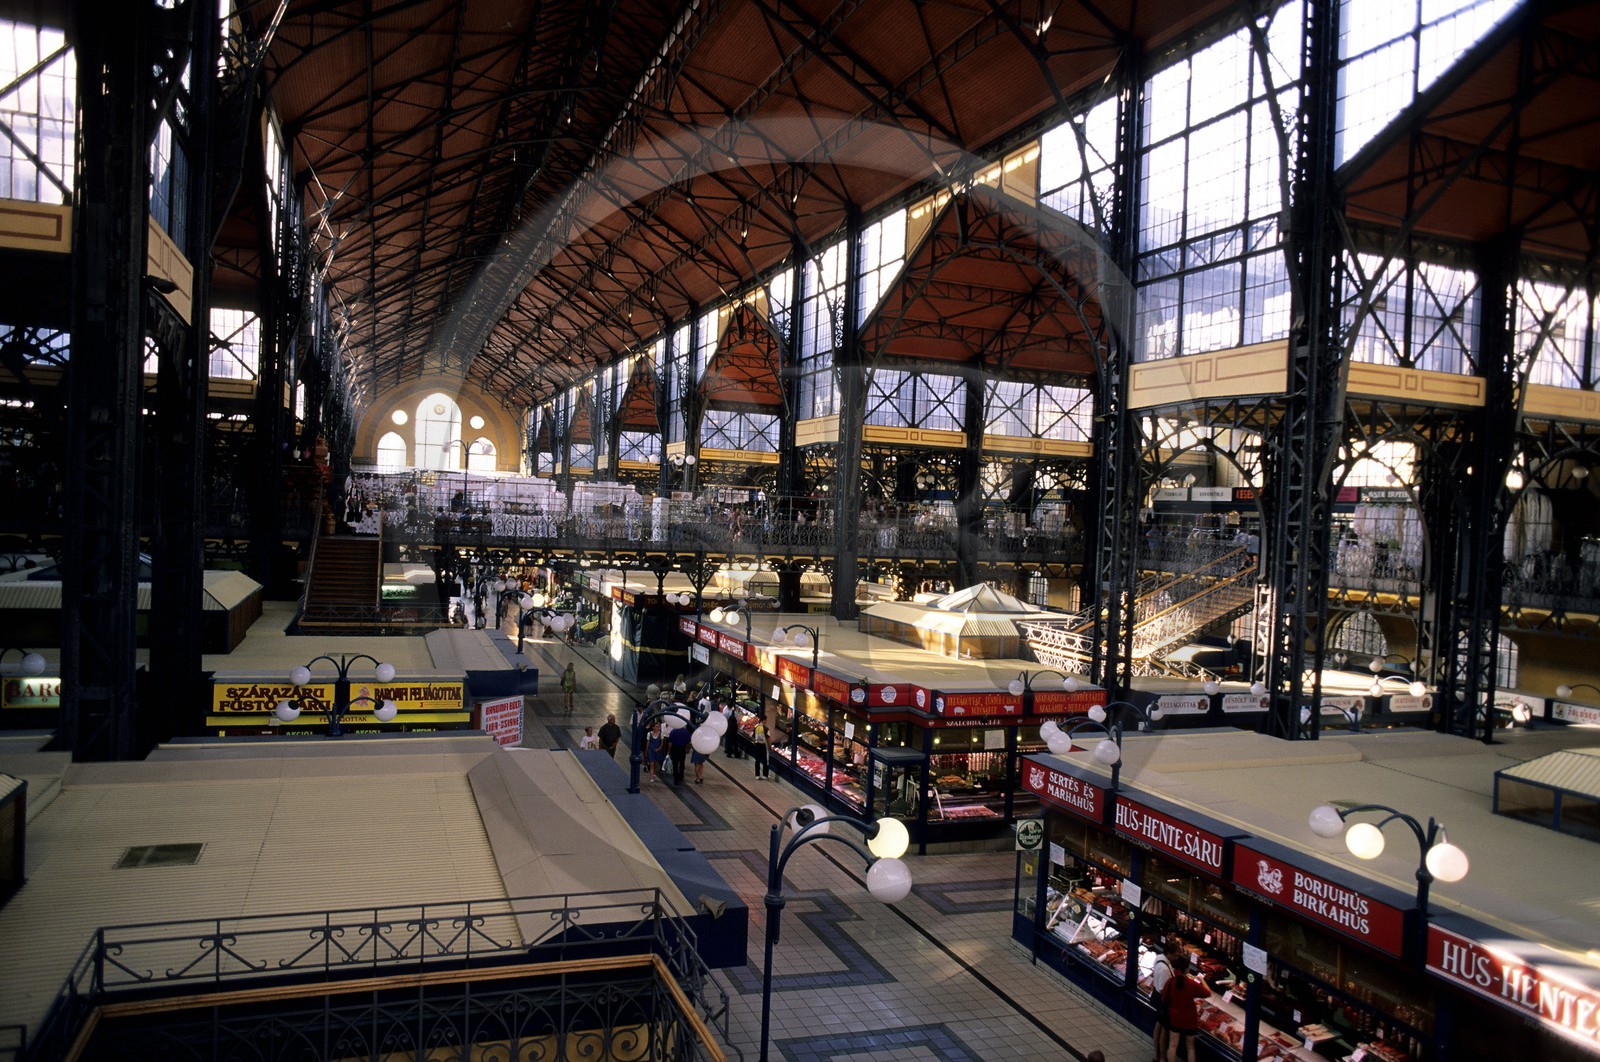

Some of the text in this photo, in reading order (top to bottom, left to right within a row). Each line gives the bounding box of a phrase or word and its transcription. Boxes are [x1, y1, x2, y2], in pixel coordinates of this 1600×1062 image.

[410, 683, 462, 701] FELVÁGOTTAK
[1047, 783, 1095, 813] MARHAHÚS
[1049, 771, 1094, 799] SERTÉS ÉS
[1294, 871, 1369, 916] BORJUHÚS
[1293, 888, 1370, 935] BIRKAHÚS
